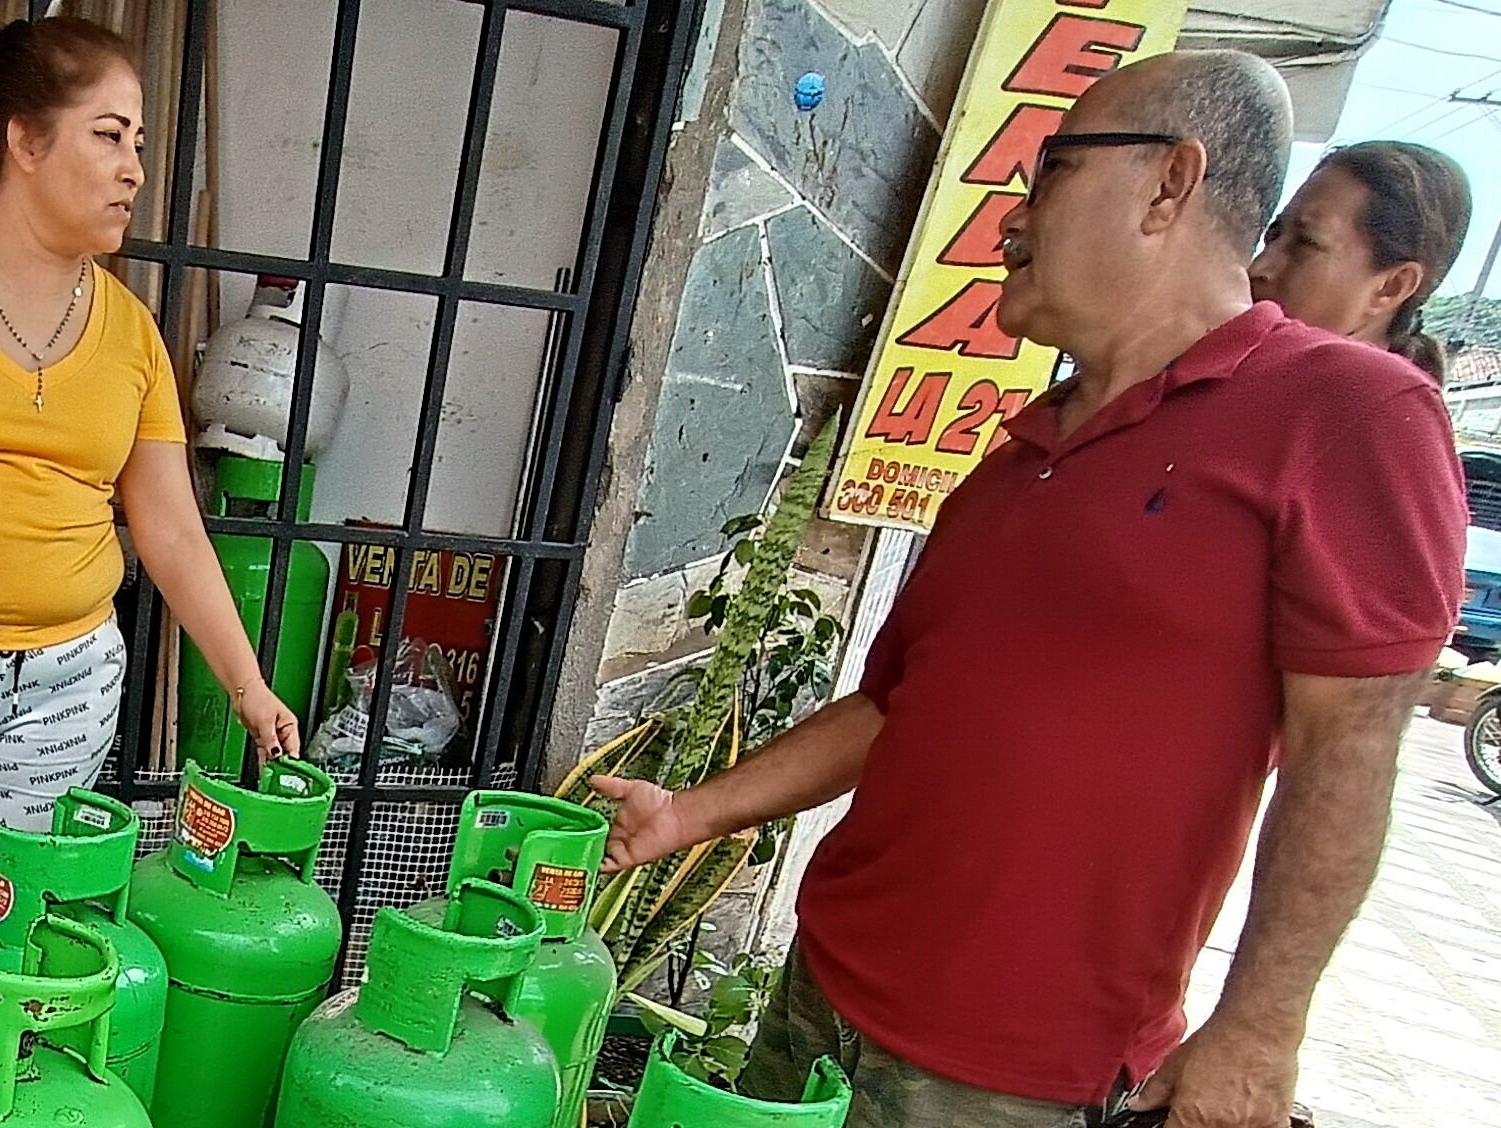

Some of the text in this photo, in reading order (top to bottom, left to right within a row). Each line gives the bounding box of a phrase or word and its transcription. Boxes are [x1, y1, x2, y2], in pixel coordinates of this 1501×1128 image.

[865, 366, 1033, 459] LA 21
[886, 487, 933, 524] 501
[446, 551, 495, 603] DE
[56, 633, 98, 666] PINKPINK
[49, 666, 93, 695] PINKPINK
[41, 701, 90, 727] PINKPINK
[36, 733, 88, 757] PINKPINK
[29, 765, 79, 786] PINKPINK
